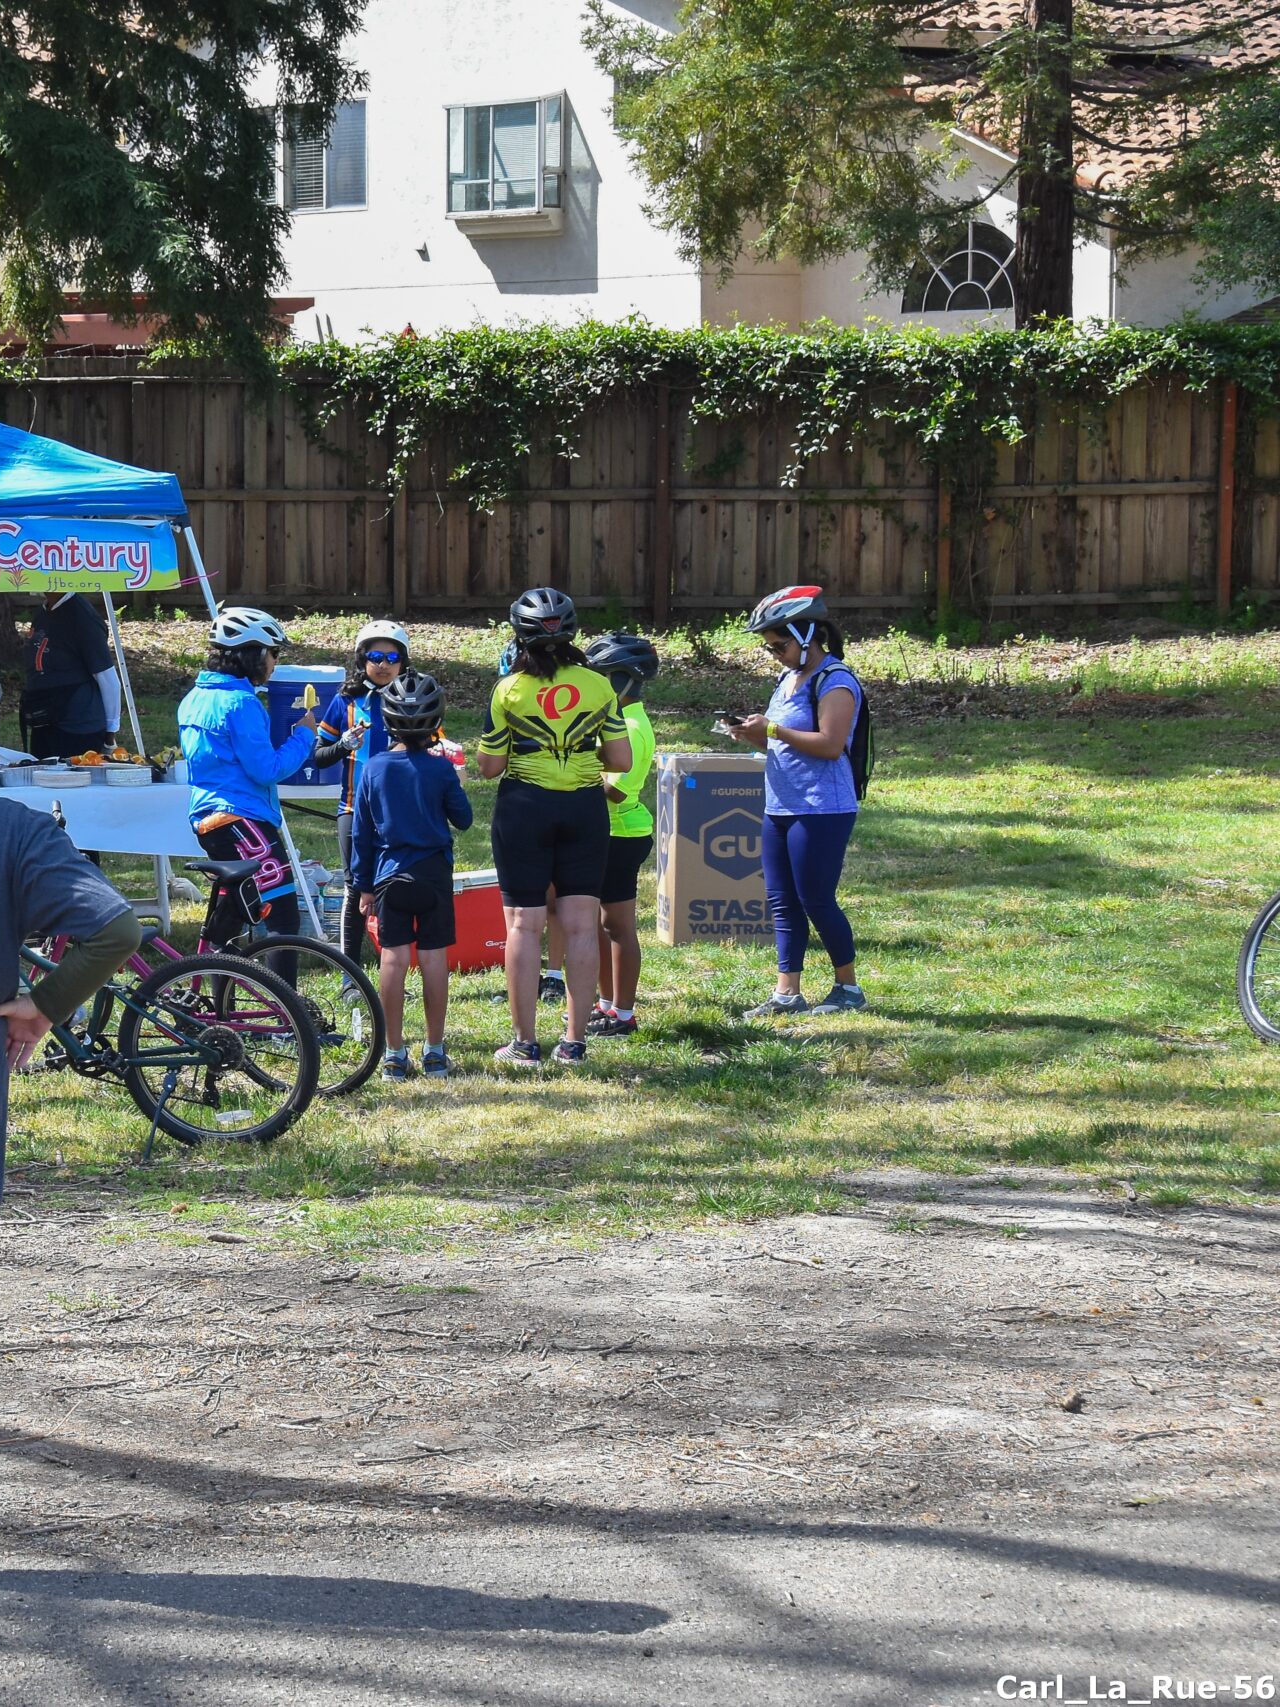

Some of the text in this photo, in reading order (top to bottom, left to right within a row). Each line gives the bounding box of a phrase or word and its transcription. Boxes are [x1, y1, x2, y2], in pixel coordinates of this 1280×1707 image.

[47, 576, 102, 592] ffbc.org
[711, 787, 762, 797] #GUFORIT
[709, 835, 763, 859] GU
[689, 923, 775, 936] YOUR TRAS
